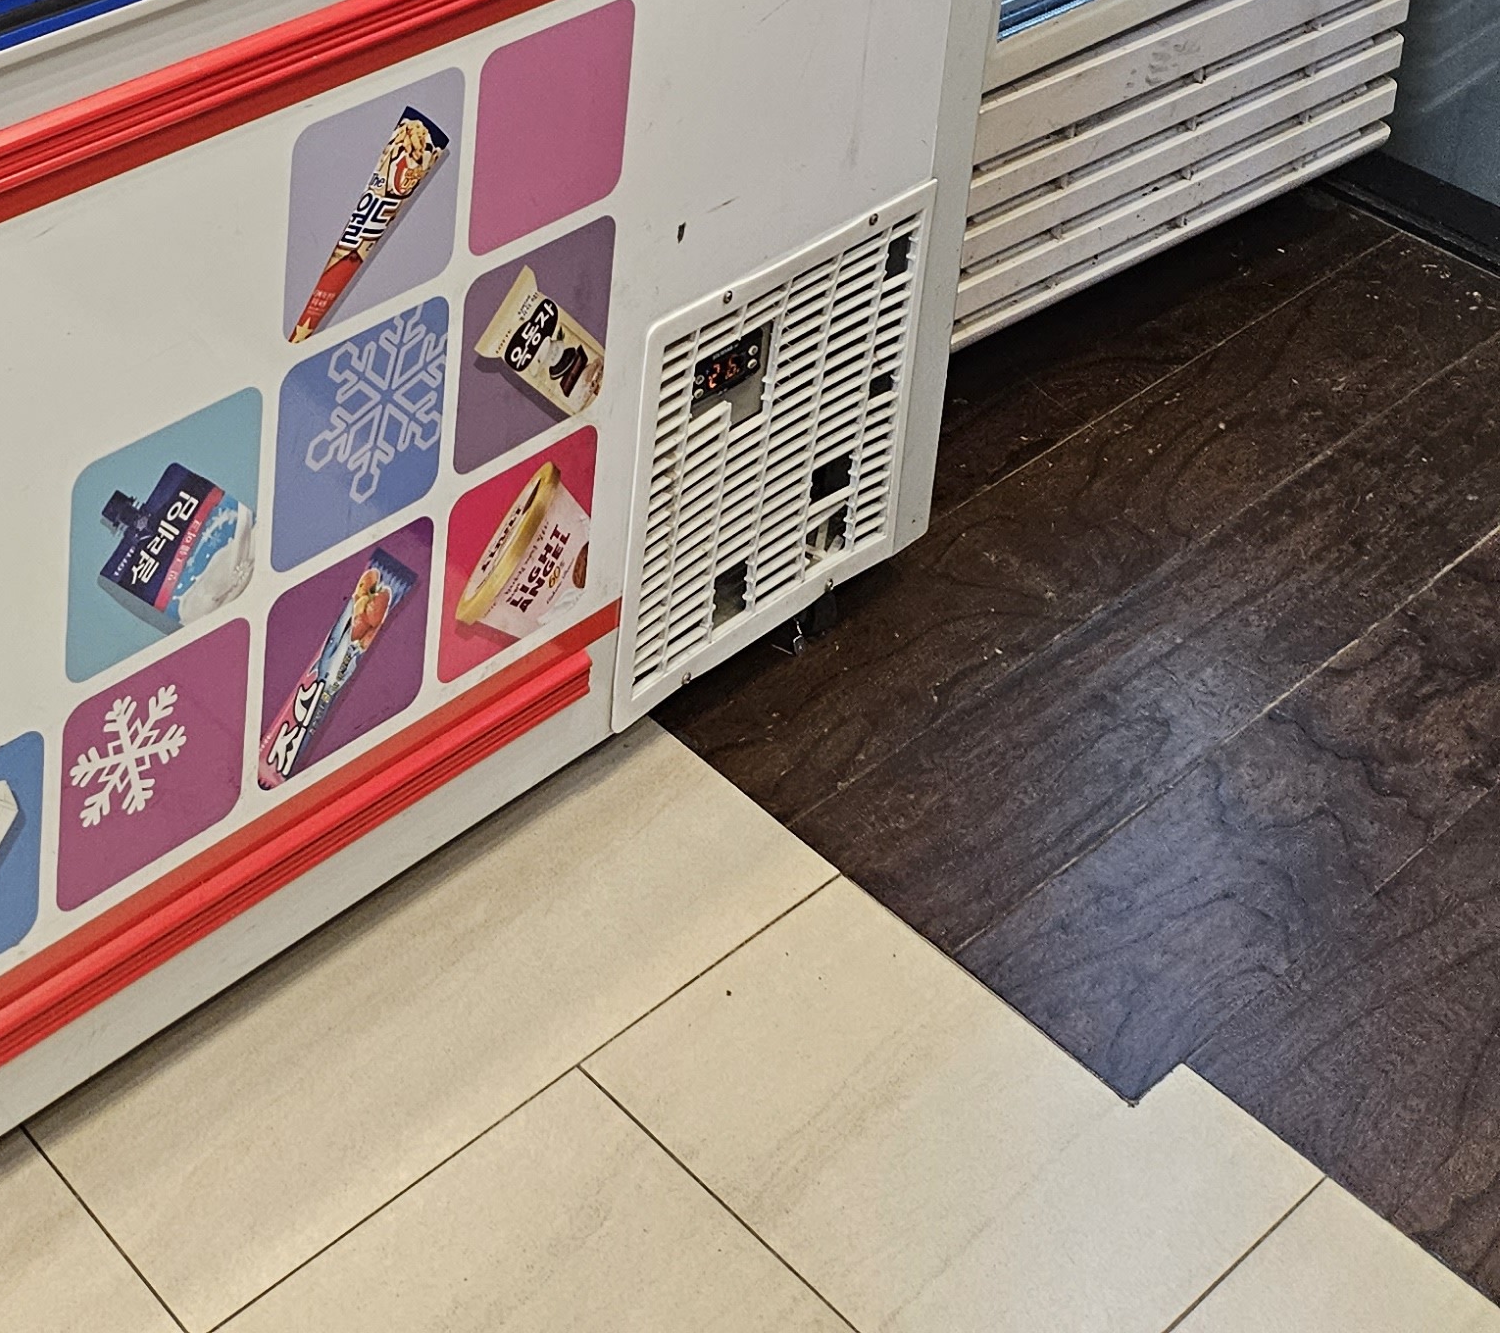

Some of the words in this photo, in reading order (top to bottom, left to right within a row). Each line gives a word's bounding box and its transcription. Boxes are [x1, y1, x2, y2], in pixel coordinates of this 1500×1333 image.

[510, 300, 555, 369] 옥동자
[129, 490, 200, 586] 설레임
[510, 524, 562, 607] LIGHT
[517, 531, 572, 614] ANGEL
